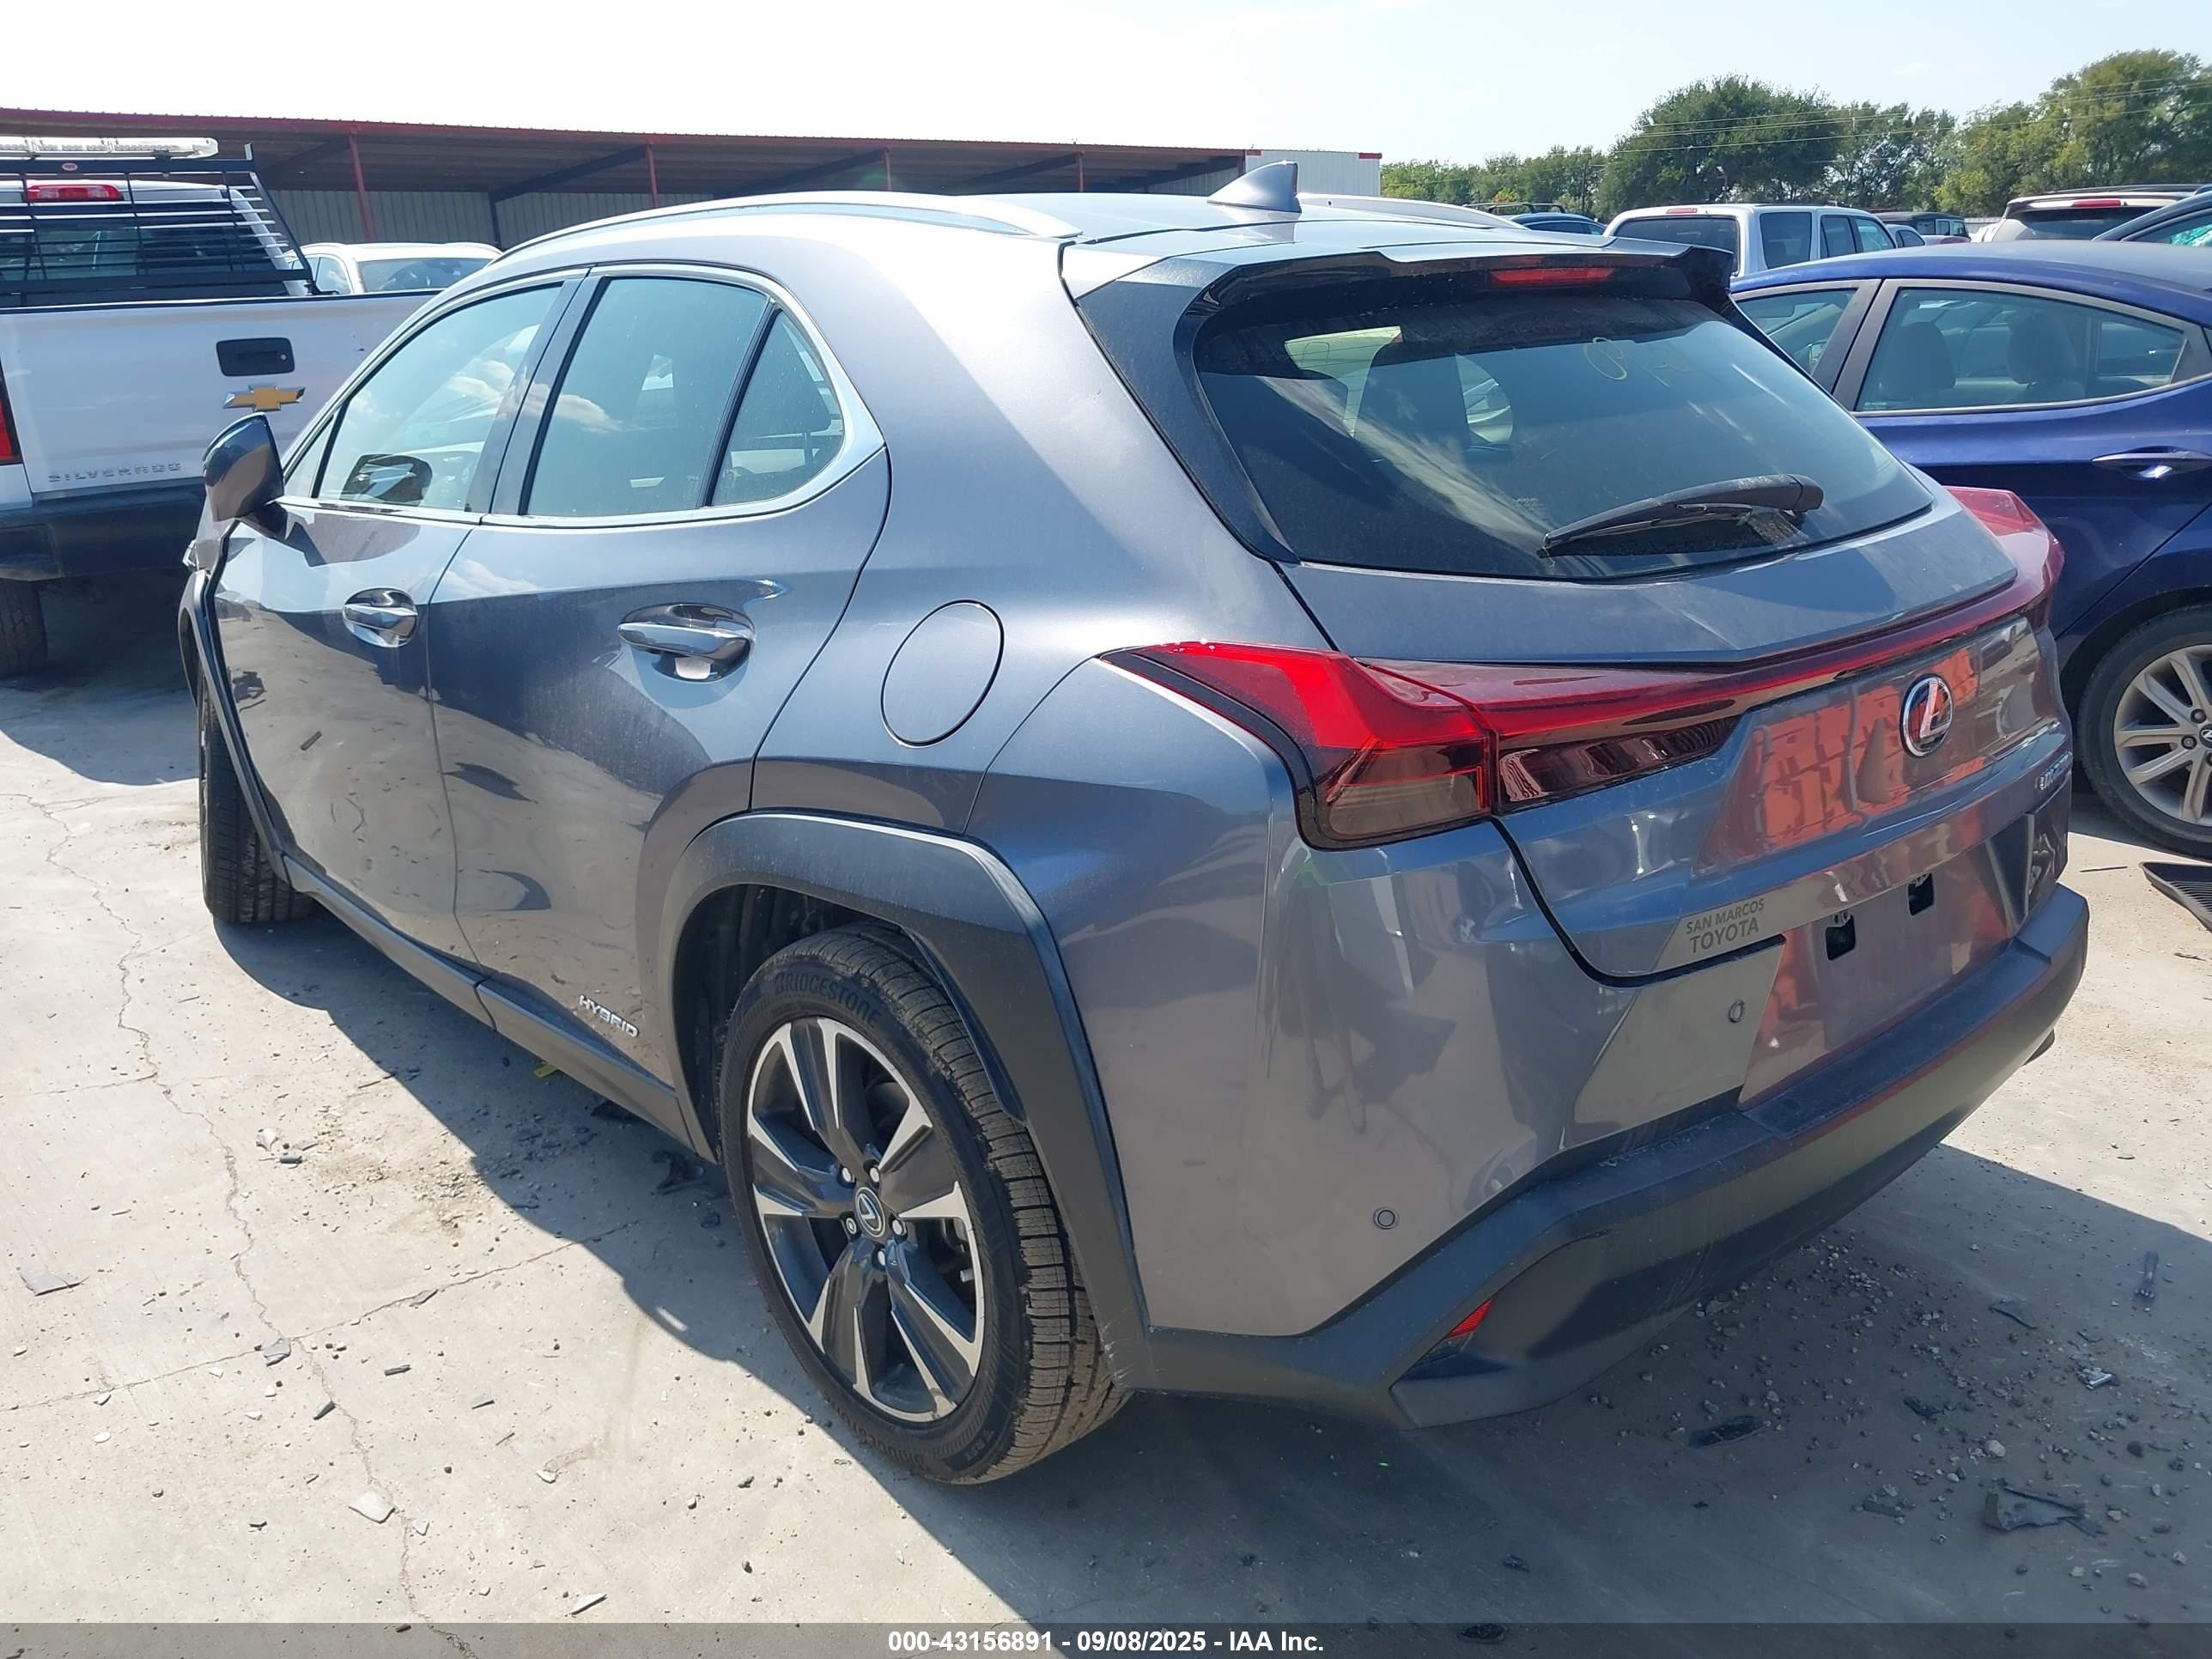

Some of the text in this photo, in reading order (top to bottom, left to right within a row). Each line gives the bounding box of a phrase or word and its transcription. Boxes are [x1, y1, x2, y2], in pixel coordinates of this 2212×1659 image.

[48, 461, 181, 483] SILVERADO
[1686, 898, 1765, 935] SAN MARCOS
[1689, 916, 1759, 954] TOYOTA
[579, 994, 639, 1037] HYBRID
[774, 971, 882, 1029] BRIDGESTONE
